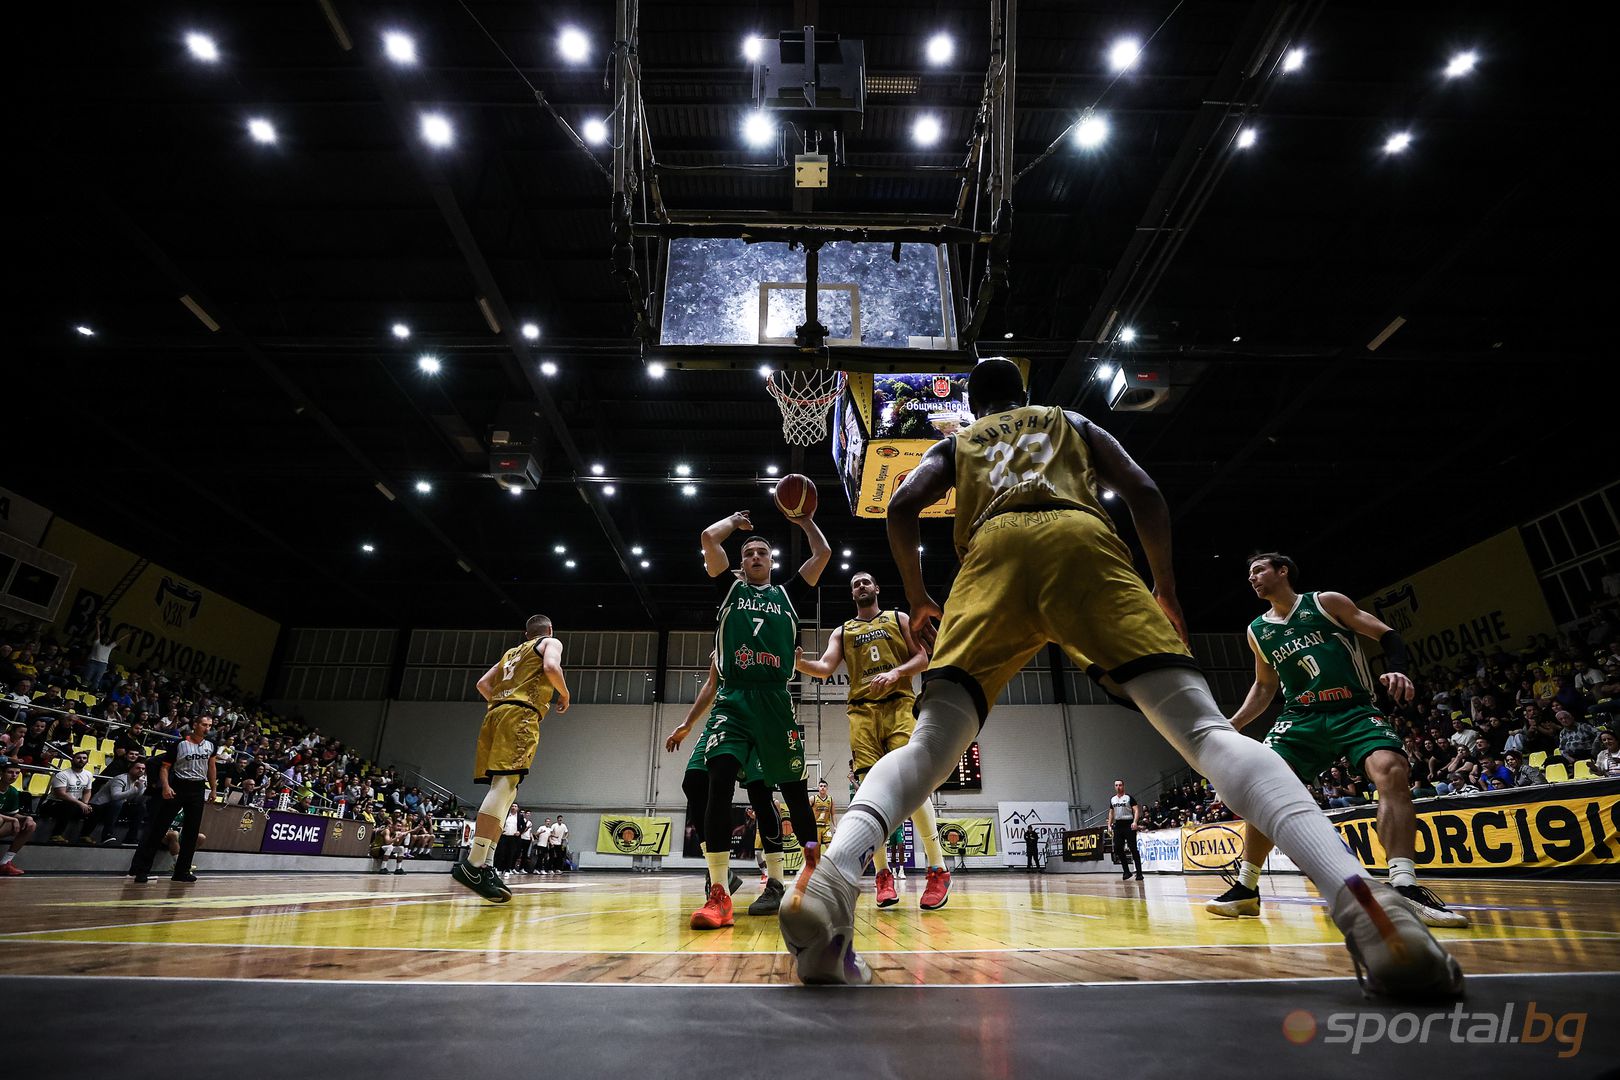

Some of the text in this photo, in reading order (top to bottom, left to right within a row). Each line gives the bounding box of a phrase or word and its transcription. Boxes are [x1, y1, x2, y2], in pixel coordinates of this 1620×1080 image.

[906, 402, 943, 412] Община
[972, 415, 1053, 447] MURPHY
[737, 598, 782, 615] BALKAN
[752, 617, 764, 637] 7
[870, 645, 880, 662] 8
[1271, 631, 1325, 664] BALKAN
[1297, 654, 1320, 680] 10
[270, 821, 320, 844] SESAME
[1190, 838, 1238, 857] DEMAX
